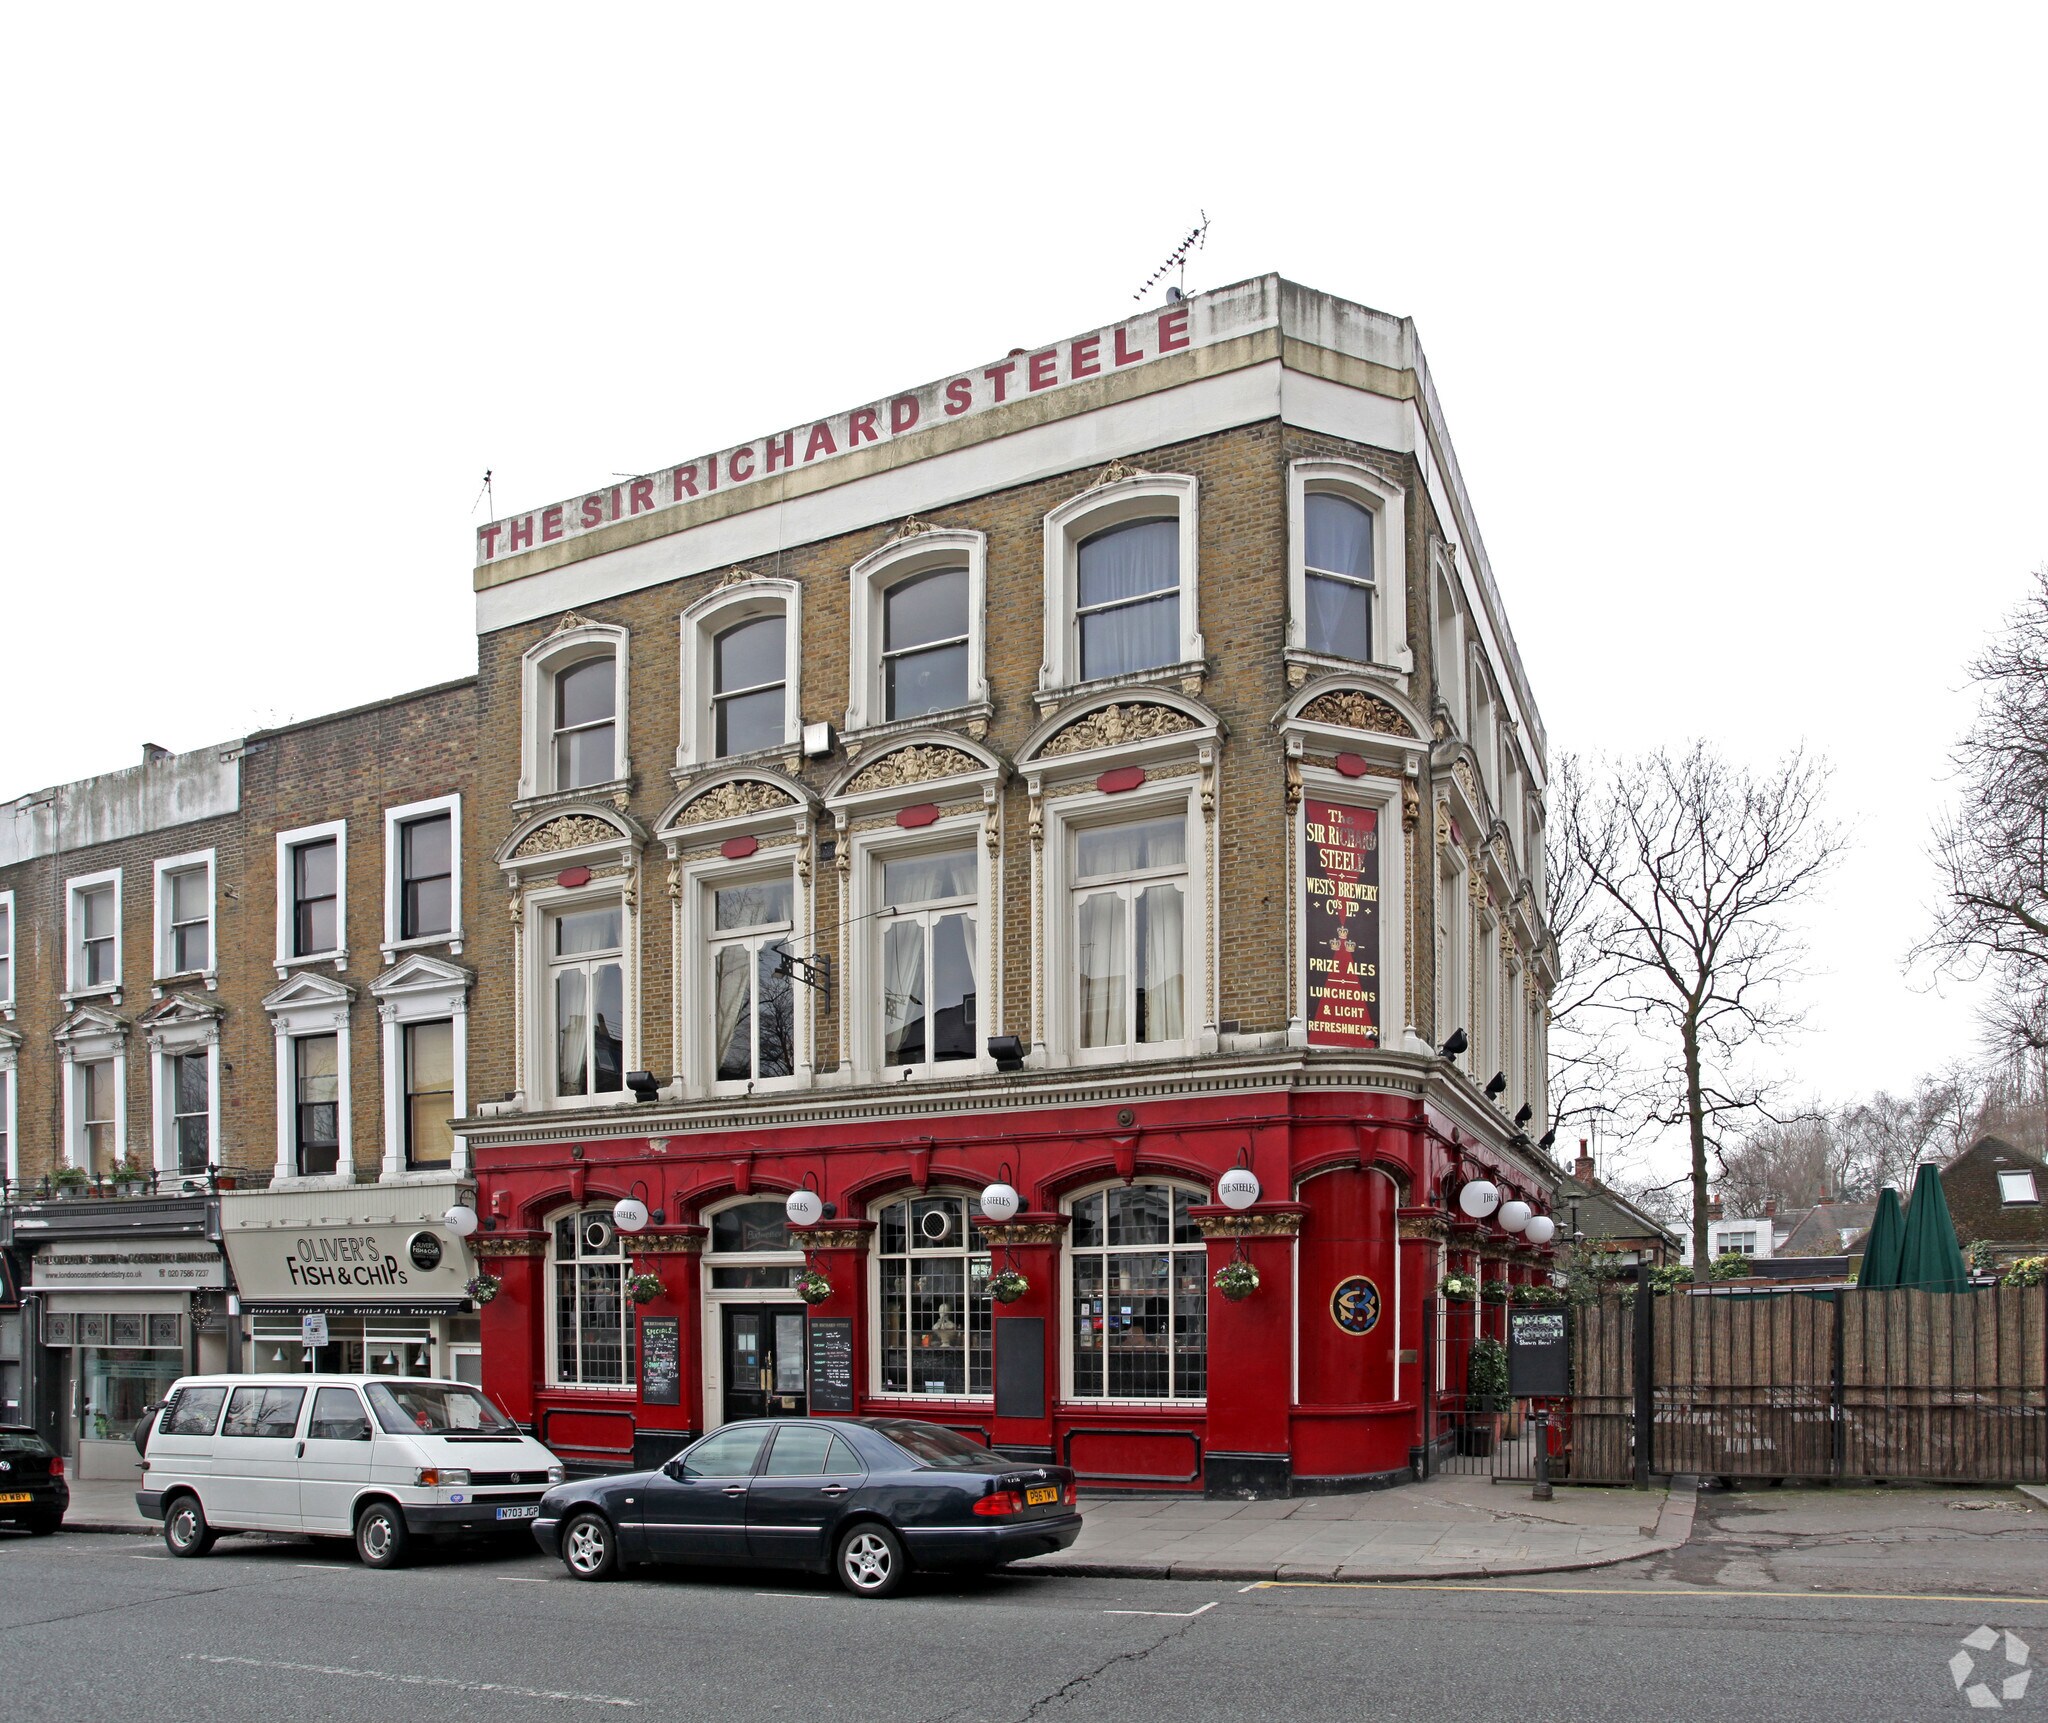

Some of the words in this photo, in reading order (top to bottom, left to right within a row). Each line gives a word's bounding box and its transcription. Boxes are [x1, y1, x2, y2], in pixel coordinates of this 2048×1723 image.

[479, 506, 563, 560] THE
[580, 478, 656, 529] SIR
[673, 394, 920, 502] RICHARD
[943, 308, 1190, 416] STEELE
[1306, 822, 1326, 844] SIR
[1328, 825, 1377, 851] RICHARD
[1319, 848, 1366, 873] STEELE
[1338, 881, 1379, 902] BREWERY
[1309, 957, 1340, 973] PRIZE
[1346, 962, 1376, 977] ALES
[1309, 986, 1376, 1003] LUNCHEONS
[1323, 1004, 1331, 1016] &
[1334, 1005, 1365, 1019] LIGHT
[1308, 1020, 1379, 1037] REFRESHMENTS
[1220, 1183, 1231, 1195] THE
[1231, 1182, 1256, 1195] STEELES
[986, 1196, 1011, 1207] STEELES
[616, 1210, 637, 1221] STEELES
[297, 1236, 380, 1262] OLIVER'S
[324, 1307, 345, 1316] Chips
[502, 1507, 523, 1518] N703
[523, 1506, 539, 1517] JGP
